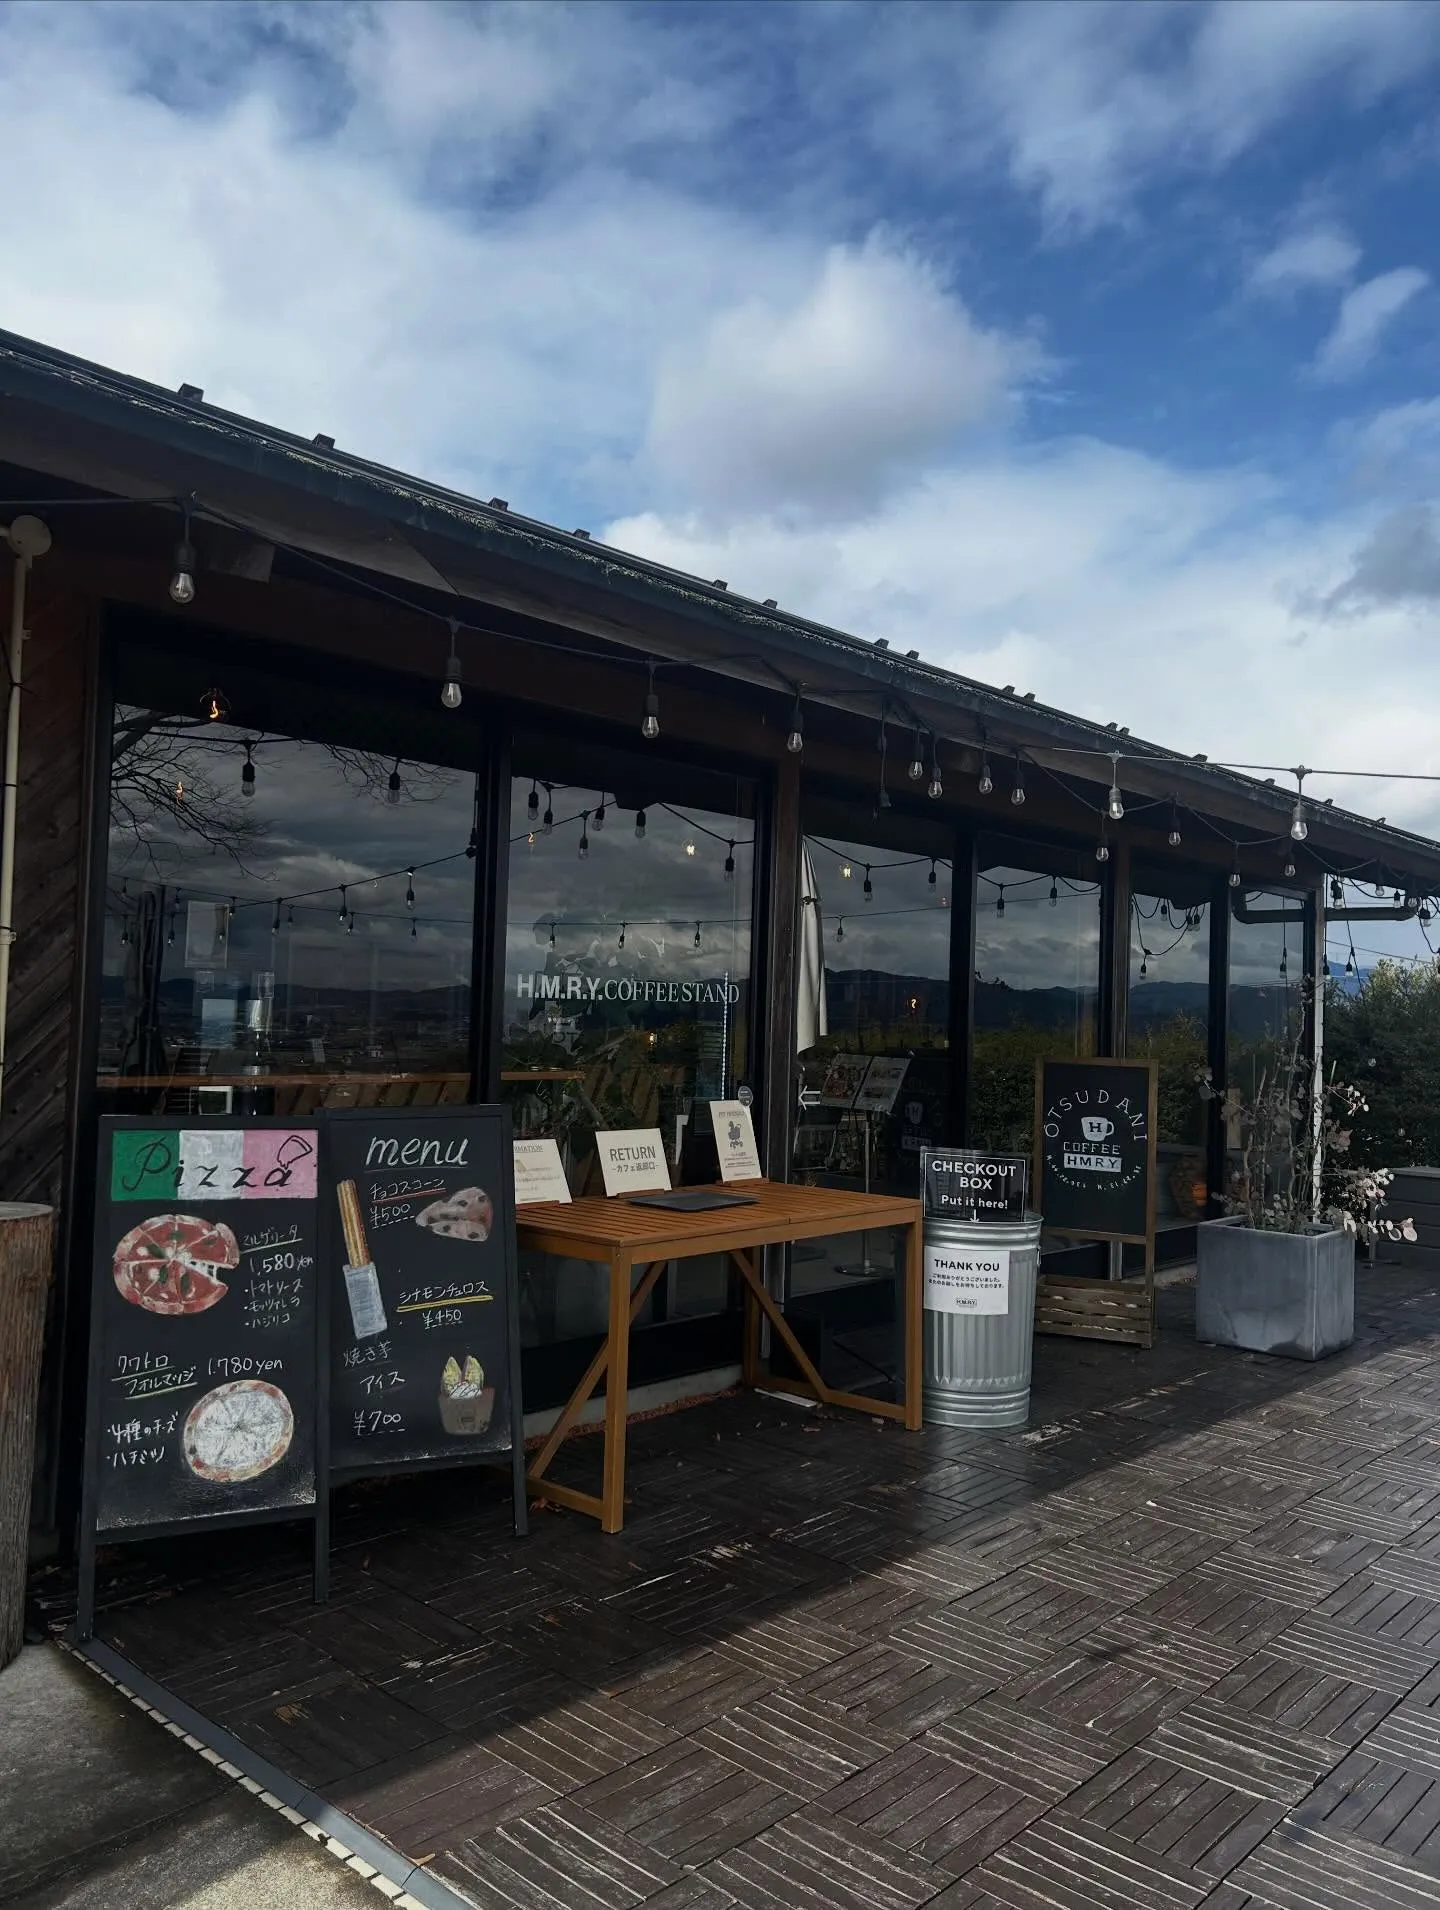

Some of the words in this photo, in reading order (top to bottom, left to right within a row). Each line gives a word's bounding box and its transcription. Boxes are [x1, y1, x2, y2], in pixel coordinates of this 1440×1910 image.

[604, 978, 680, 1002] COFFEE
[681, 982, 740, 1003] STAND
[1043, 1089, 1148, 1141] OTSUDANI
[365, 1136, 468, 1167] menu
[610, 1146, 657, 1162] RETURN
[1063, 1141, 1121, 1155] COFFEE
[122, 1136, 292, 1192] Pizza
[931, 1159, 1016, 1178] CHECKOUT
[1066, 1155, 1119, 1169] HMRY
[369, 1178, 445, 1201] チョコスコーン
[959, 1176, 993, 1190] BOX
[941, 1194, 962, 1206] Put
[964, 1196, 975, 1207] it
[978, 1197, 1009, 1209] here!
[370, 1203, 411, 1227] ¥500
[934, 1258, 973, 1271] THANK
[975, 1262, 1000, 1272] YOU
[422, 1309, 462, 1328] ¥450
[343, 1341, 392, 1367] 焼き芋
[256, 1358, 283, 1375] yen
[360, 1371, 405, 1394] アイス
[354, 1409, 402, 1436] ¥700
